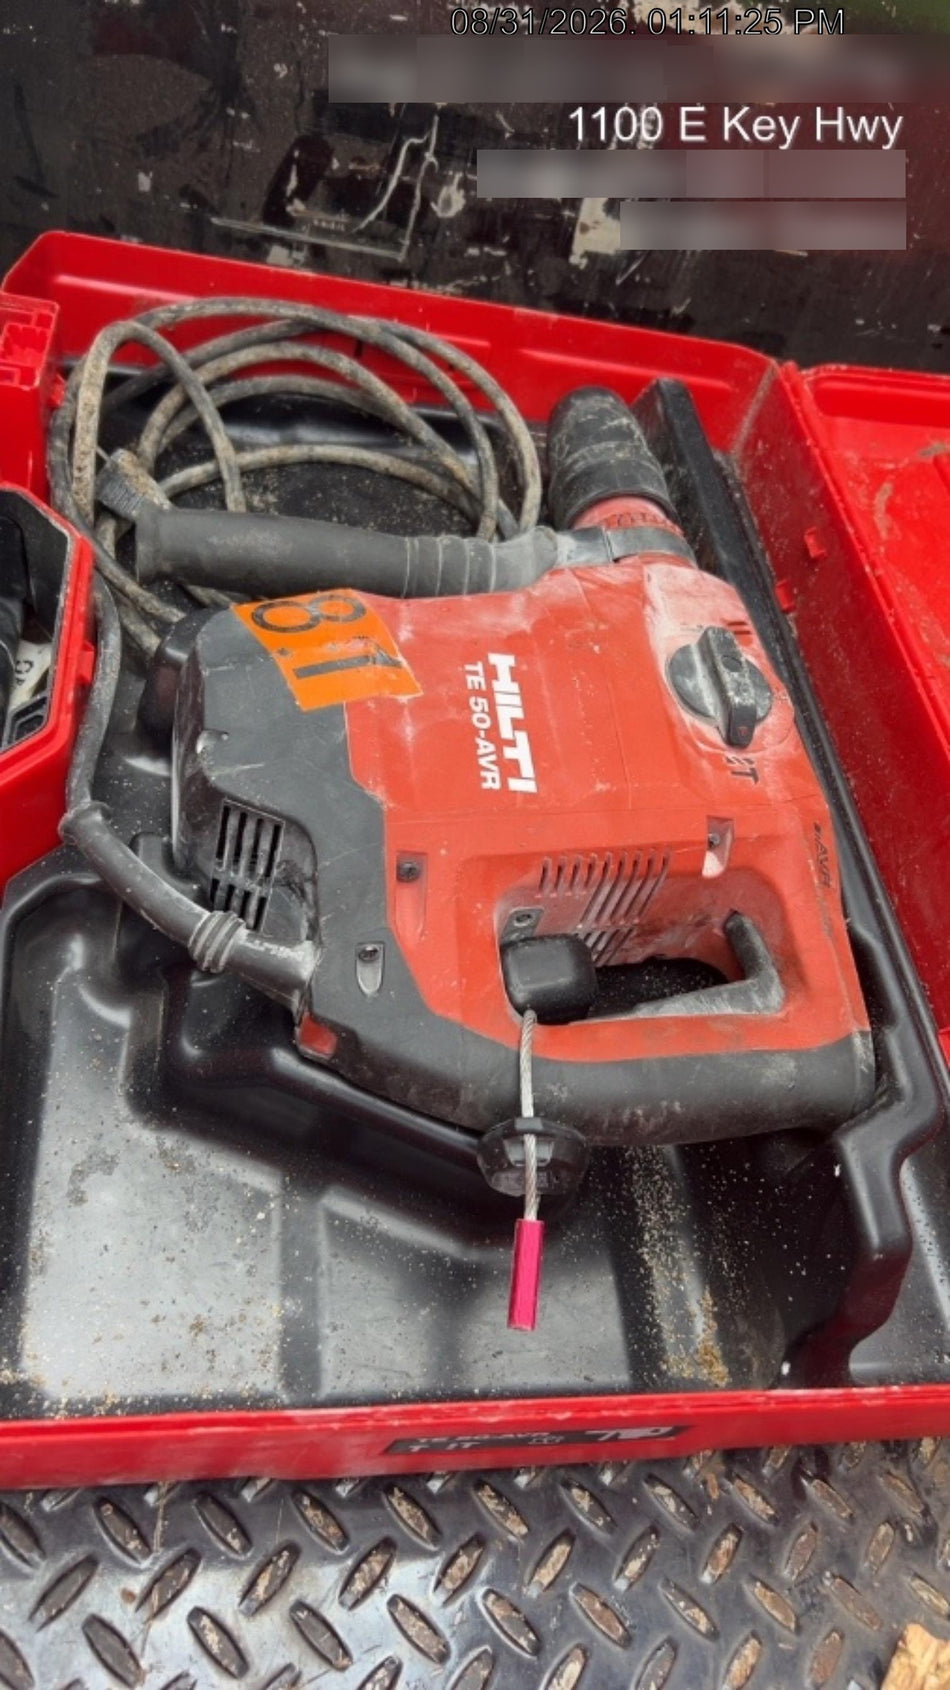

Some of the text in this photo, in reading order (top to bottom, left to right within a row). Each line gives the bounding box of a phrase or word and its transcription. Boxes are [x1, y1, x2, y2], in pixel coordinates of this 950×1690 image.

[464, 661, 501, 790] TE 50-AVR
[488, 653, 538, 793] HILTI
